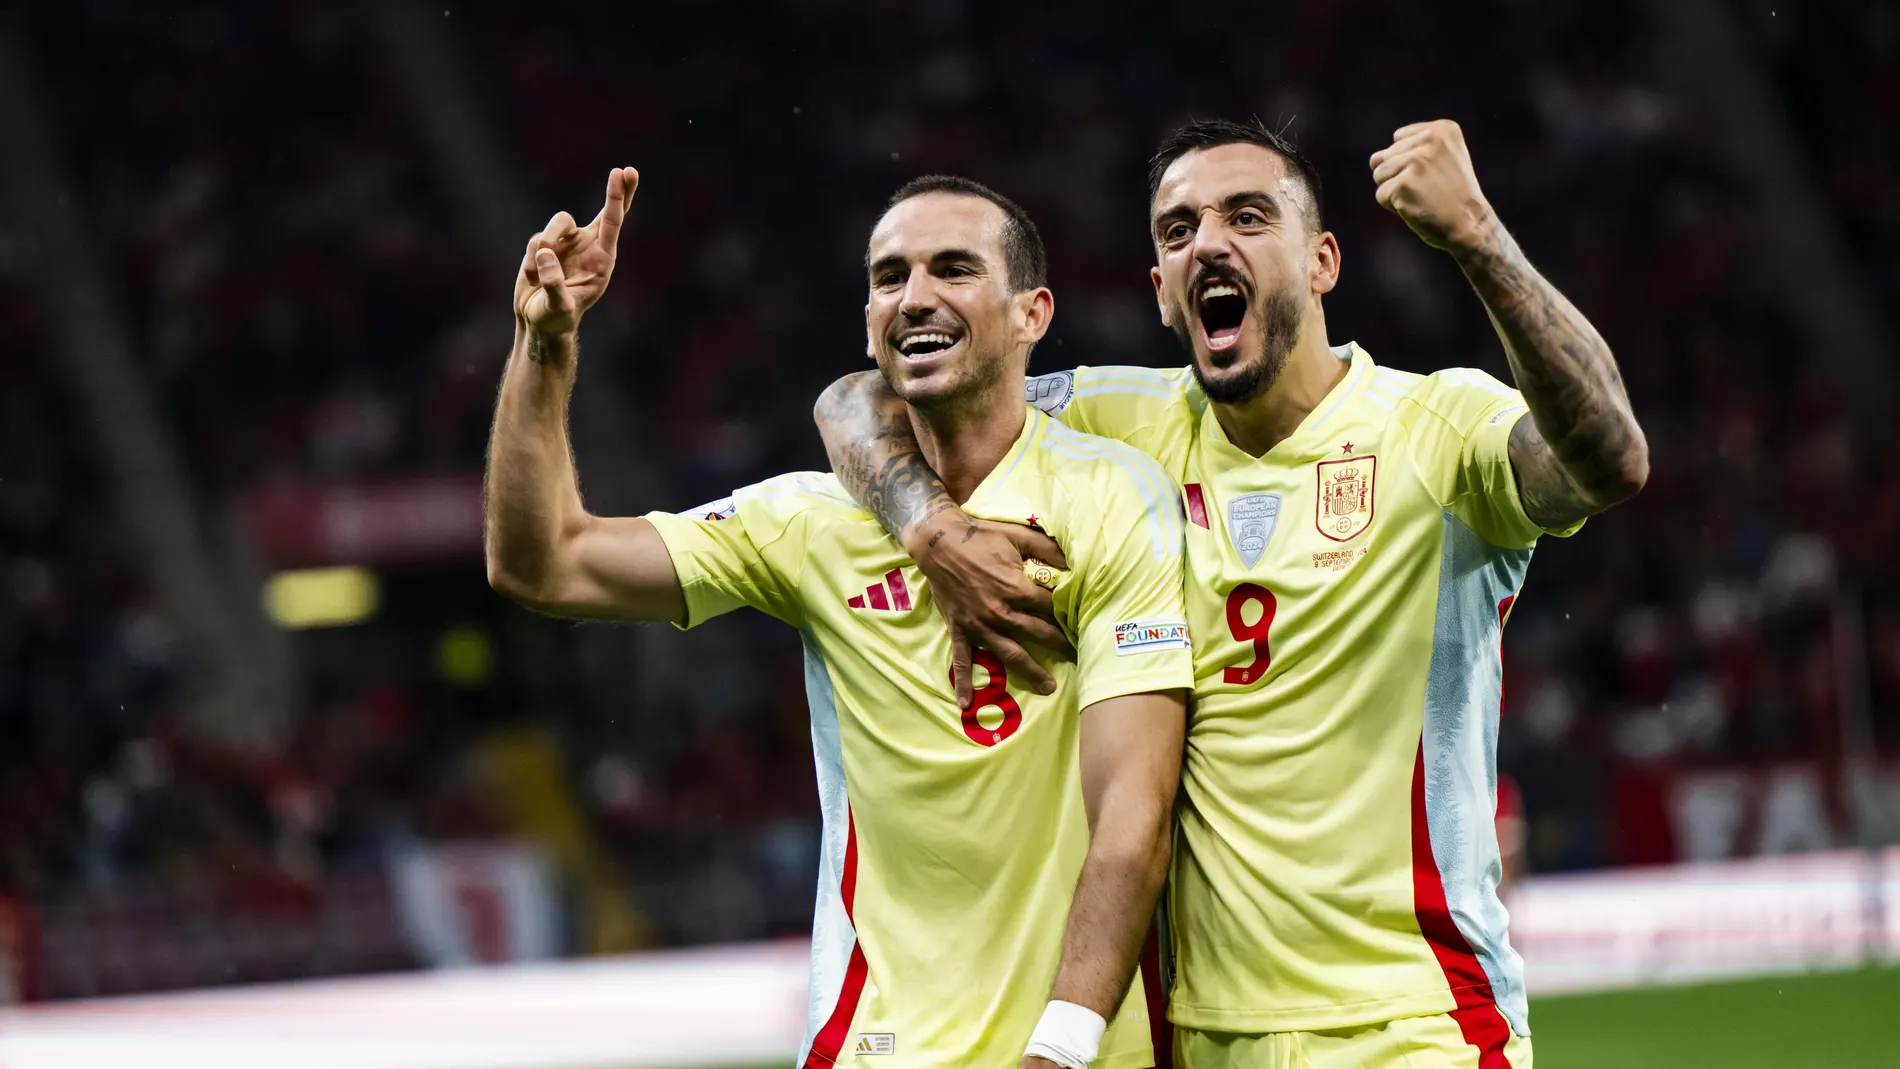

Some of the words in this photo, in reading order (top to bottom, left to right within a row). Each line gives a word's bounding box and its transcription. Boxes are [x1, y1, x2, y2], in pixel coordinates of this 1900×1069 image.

[1233, 502, 1277, 513] EUROPEAN
[1232, 509, 1277, 520] CHAMPIONS
[1240, 541, 1264, 552] 2024
[1312, 550, 1354, 561] SWITZERLAND
[1115, 623, 1138, 633] UEFA
[1223, 582, 1277, 685] 9
[949, 648, 1022, 747] 8
